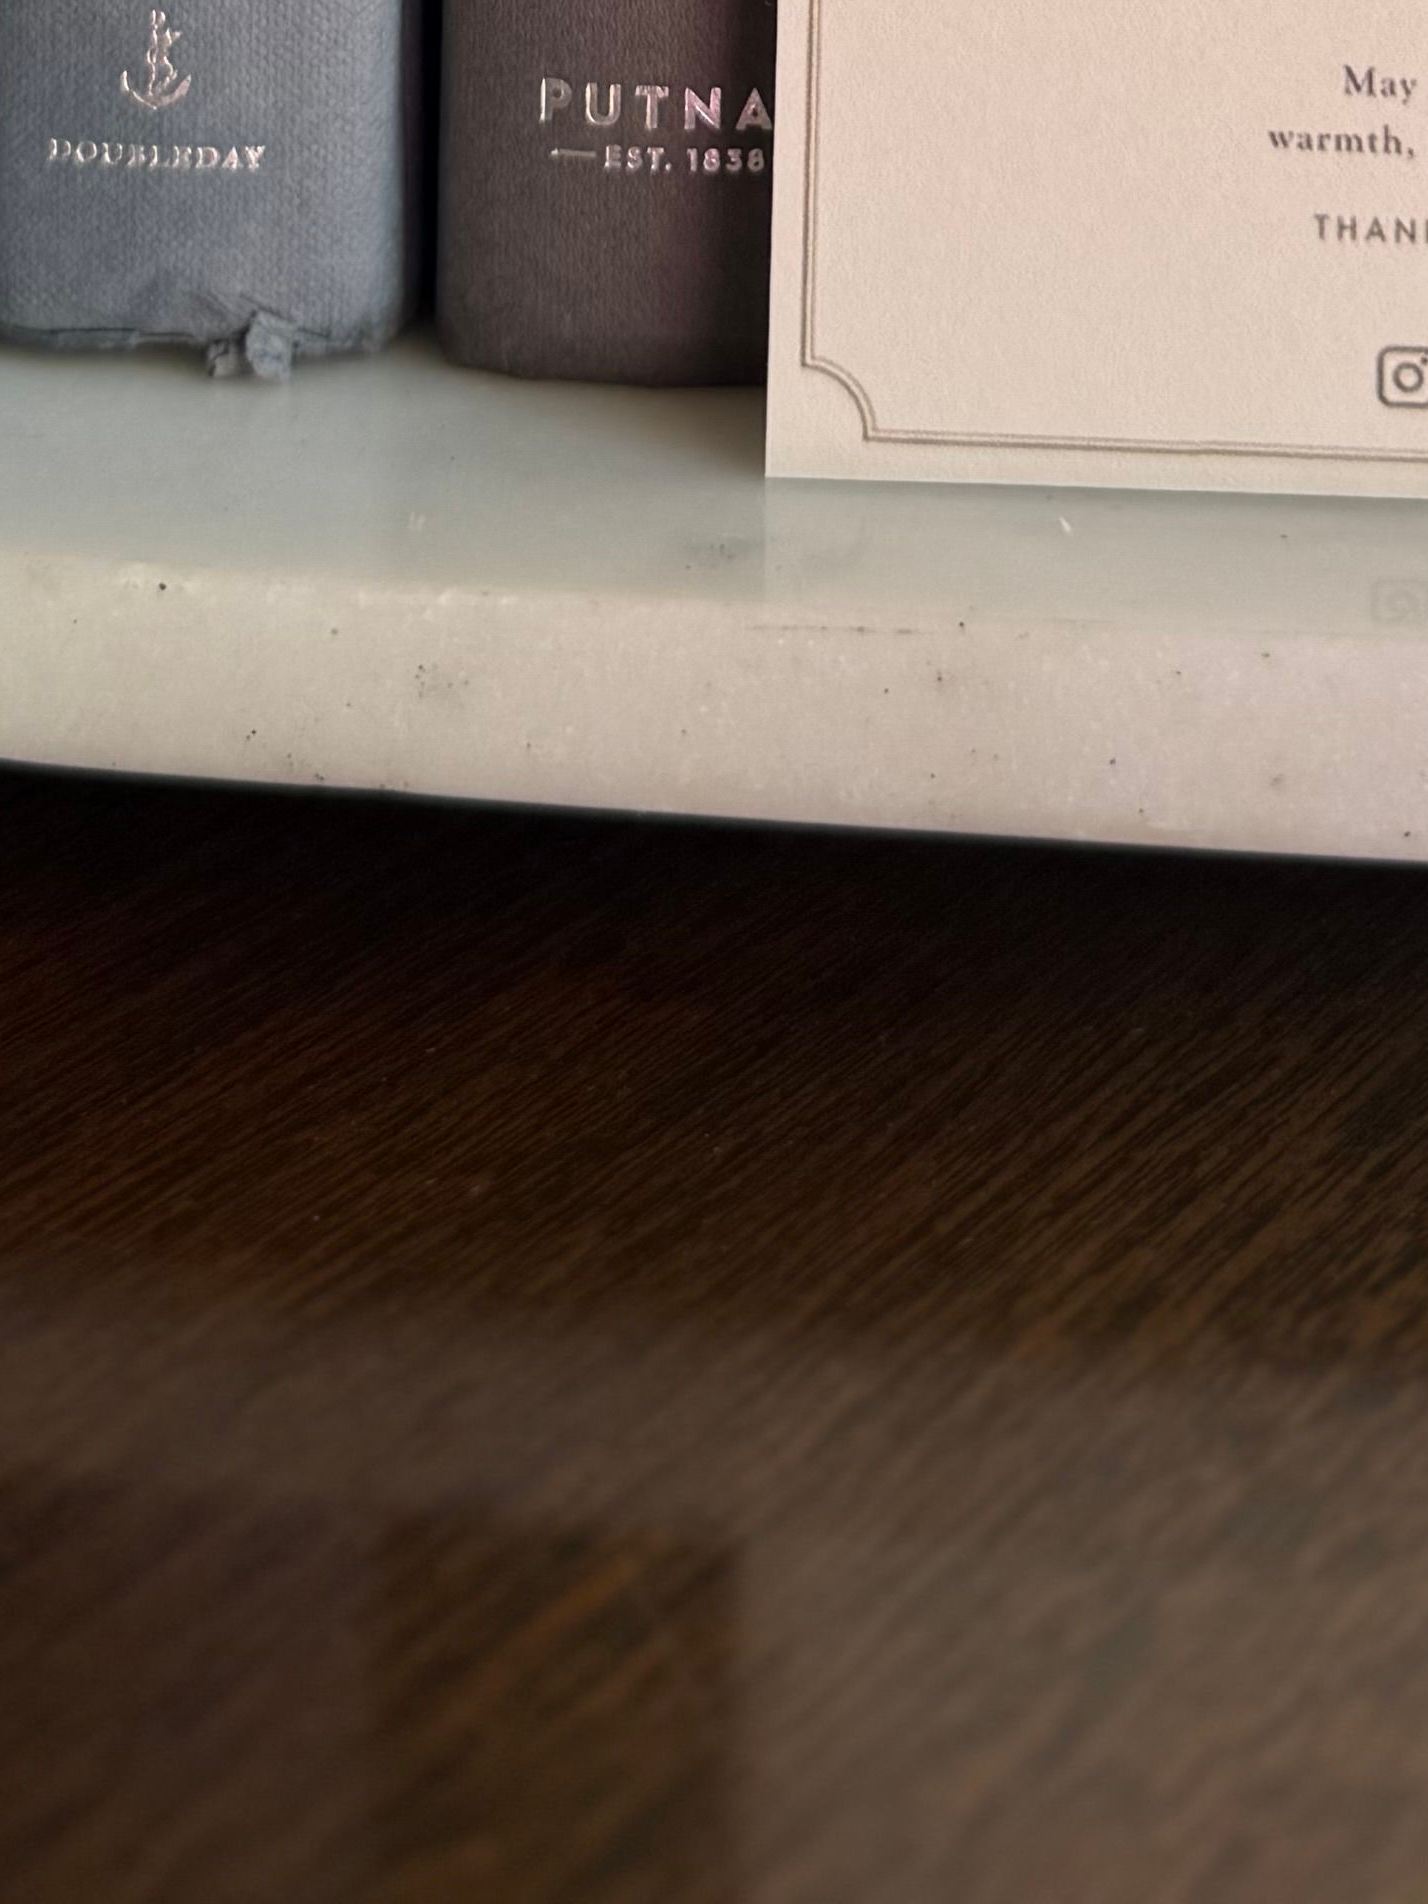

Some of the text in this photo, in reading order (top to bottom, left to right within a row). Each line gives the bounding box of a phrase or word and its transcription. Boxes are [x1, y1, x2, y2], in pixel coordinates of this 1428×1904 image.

[539, 77, 772, 130] PUTNA
[1342, 64, 1418, 106] May
[46, 137, 266, 173] DOUBLEDAY
[604, 144, 765, 173] EST. 1838
[1267, 123, 1416, 161] warmth,
